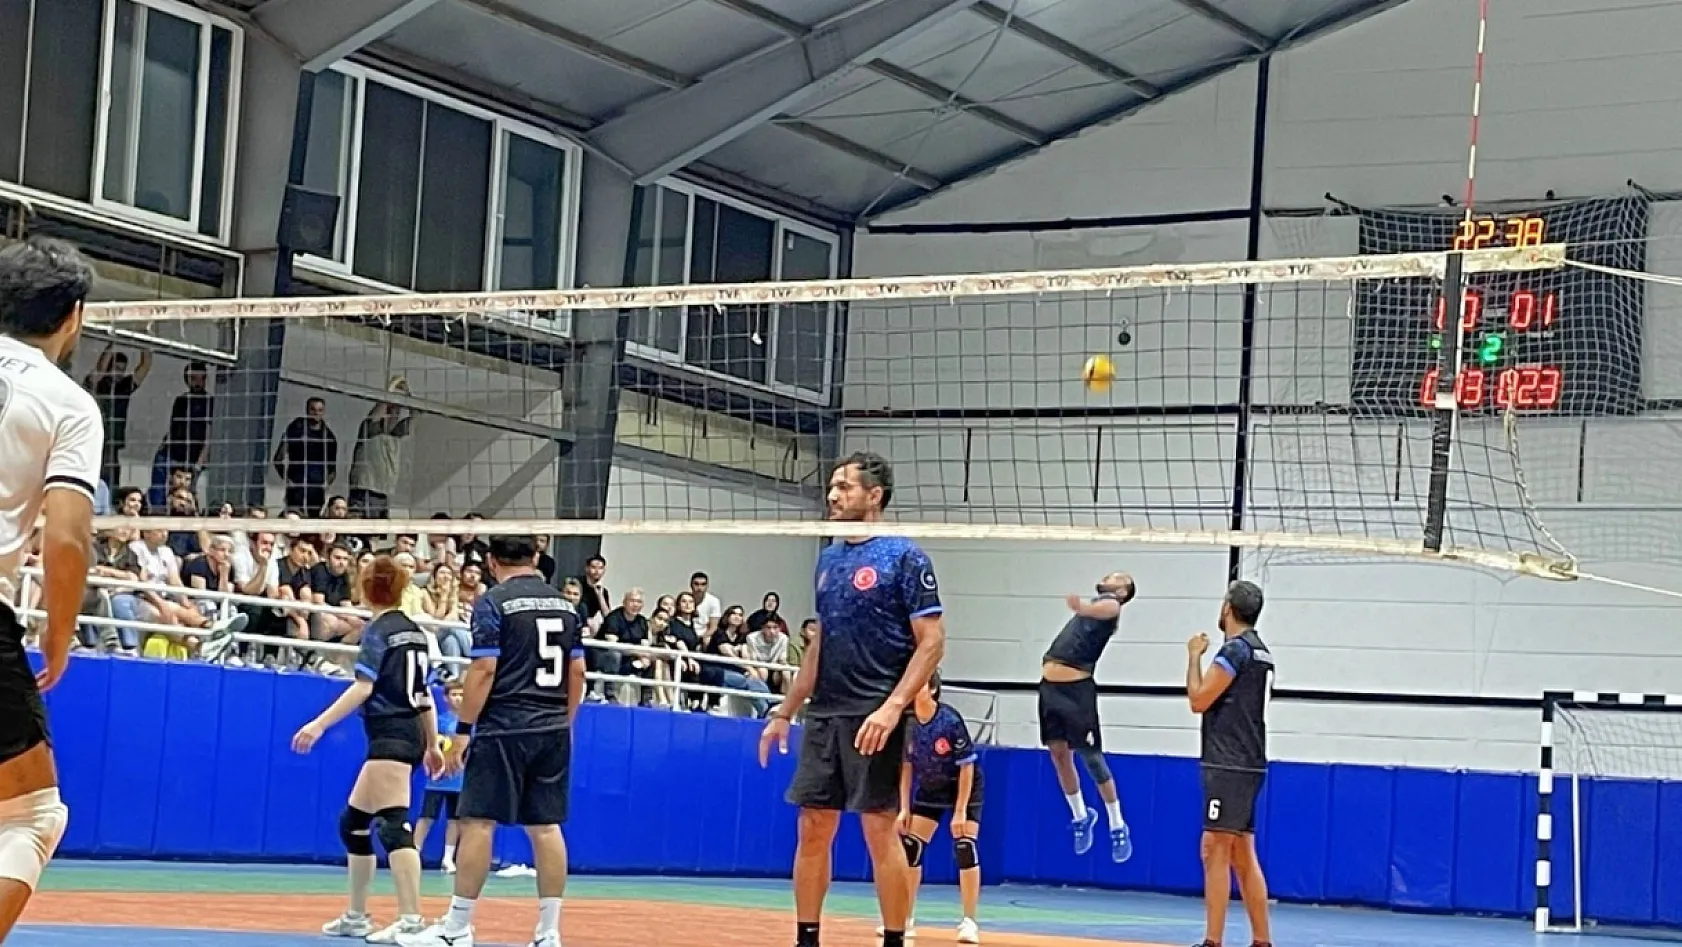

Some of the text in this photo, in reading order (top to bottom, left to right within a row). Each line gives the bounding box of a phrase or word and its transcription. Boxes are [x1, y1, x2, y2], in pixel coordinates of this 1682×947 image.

[567, 294, 587, 304] TVF
[615, 293, 636, 302] TVF
[667, 291, 688, 300] TVF
[718, 289, 740, 299] TVF
[771, 288, 792, 298] TVF
[825, 286, 845, 296] TVF
[879, 284, 901, 294] TVF
[934, 281, 957, 291] TVF
[1108, 272, 1129, 284] TVF
[1288, 264, 1312, 276] TVF
[1481, 335, 1503, 362] 2
[0, 356, 39, 374] ET
[535, 617, 564, 687] 5
[1207, 799, 1221, 820] 6
